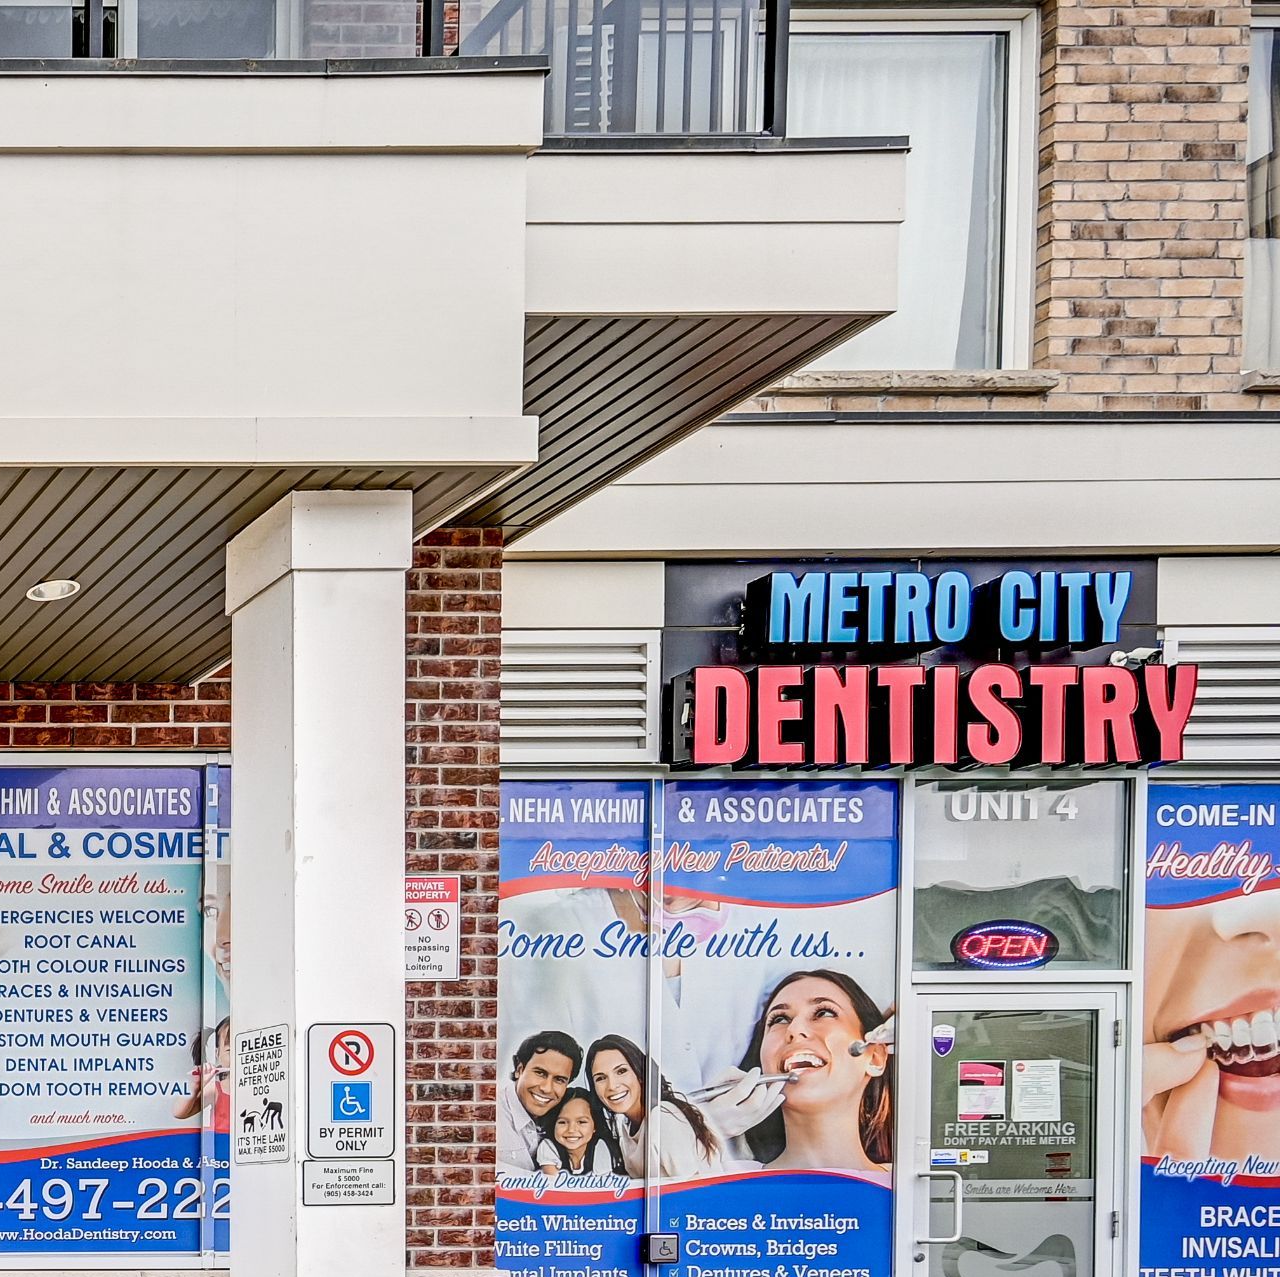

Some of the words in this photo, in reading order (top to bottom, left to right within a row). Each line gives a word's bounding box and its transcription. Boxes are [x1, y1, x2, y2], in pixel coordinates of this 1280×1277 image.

[768, 570, 972, 643] METRO
[999, 570, 1133, 643] CITY
[693, 663, 1199, 765] DENTISTRY
[47, 788, 61, 815] &
[68, 787, 192, 816] ASSOCIATES
[951, 791, 1038, 821] UNIT
[1056, 794, 1079, 820] 4
[509, 798, 564, 823] NEHA
[570, 798, 645, 824] YAKHMI
[678, 797, 695, 824] &
[705, 796, 864, 824] ASSOCIATES
[1156, 804, 1275, 827] COME-IN
[48, 831, 71, 860] &
[530, 841, 662, 886] Accepting
[662, 841, 721, 872] New
[724, 840, 848, 873] Patients!
[1146, 840, 1272, 896] Healthy
[38, 873, 93, 895] Smile
[98, 872, 139, 895] with
[144, 877, 185, 895] us...
[405, 881, 445, 891] PRIVATE
[405, 890, 451, 900] ROPERTY
[100, 909, 185, 924] WELCOME
[24, 934, 71, 949] ROOT
[76, 934, 137, 949] CANAL
[496, 920, 585, 958] Come
[593, 919, 697, 958] Smile
[705, 918, 784, 958] with
[790, 930, 865, 958] us...
[961, 934, 1048, 958] OPEN
[405, 944, 450, 953] respassing
[36, 959, 109, 974] COLOUR
[114, 958, 186, 973] FILLINGS
[417, 955, 431, 963] NO
[405, 963, 443, 972] Loitering
[57, 984, 69, 998] &
[75, 983, 173, 998] INVISALIGN
[79, 1008, 90, 1022] &
[96, 1008, 168, 1022] VENEERS
[50, 1033, 111, 1047] MOUTH
[116, 1032, 187, 1047] GUARDS
[241, 1033, 282, 1052] PLEASE
[5, 1058, 68, 1072] DENTAL
[74, 1057, 155, 1072] IMPLANTS
[240, 1052, 265, 1065] LEASH
[266, 1049, 283, 1061] AND
[243, 1063, 268, 1076] CLEAN
[269, 1060, 281, 1071] UP
[238, 1075, 262, 1087] AFTER
[264, 1071, 286, 1083] YOUR
[47, 1082, 103, 1096] TOOTH
[108, 1082, 191, 1096] REMOVAL
[253, 1085, 270, 1096] DOG
[29, 1111, 55, 1125] and
[57, 1110, 91, 1125] much
[93, 1114, 136, 1125] more...
[319, 1127, 335, 1138] BY
[339, 1127, 385, 1138] PERMIT
[944, 1123, 991, 1136] FREE
[995, 1122, 1076, 1136] PARKING
[237, 1136, 251, 1147] IT'S
[252, 1135, 267, 1145] THE
[268, 1133, 286, 1144] LAW
[335, 1140, 368, 1151] ONLY
[943, 1137, 976, 1146] DON'T
[978, 1137, 998, 1146] PAY
[999, 1137, 1012, 1146] AT
[1014, 1137, 1037, 1146] THE
[1039, 1136, 1076, 1145] METER
[40, 1157, 62, 1170] Dr.
[66, 1157, 129, 1172] Sandeep
[131, 1157, 180, 1170] Hooda
[182, 1157, 194, 1169] &
[1155, 1155, 1239, 1185] Accepting
[1241, 1155, 1280, 1175] New
[554, 1171, 631, 1197] Dentistry
[964, 1183, 993, 1195] Smiles
[995, 1186, 1011, 1194] are
[1013, 1183, 1053, 1195] Welcome
[495, 1215, 537, 1232] eeth
[541, 1214, 638, 1234] Whitening
[685, 1213, 748, 1231] Braces
[752, 1213, 766, 1231] &
[770, 1213, 860, 1234] Invisalign
[1200, 1206, 1280, 1228] BRACE
[544, 1240, 603, 1260] Filling
[685, 1239, 762, 1258] Crowns,
[766, 1239, 838, 1260] Bridges
[1182, 1236, 1280, 1259] INVISALI
